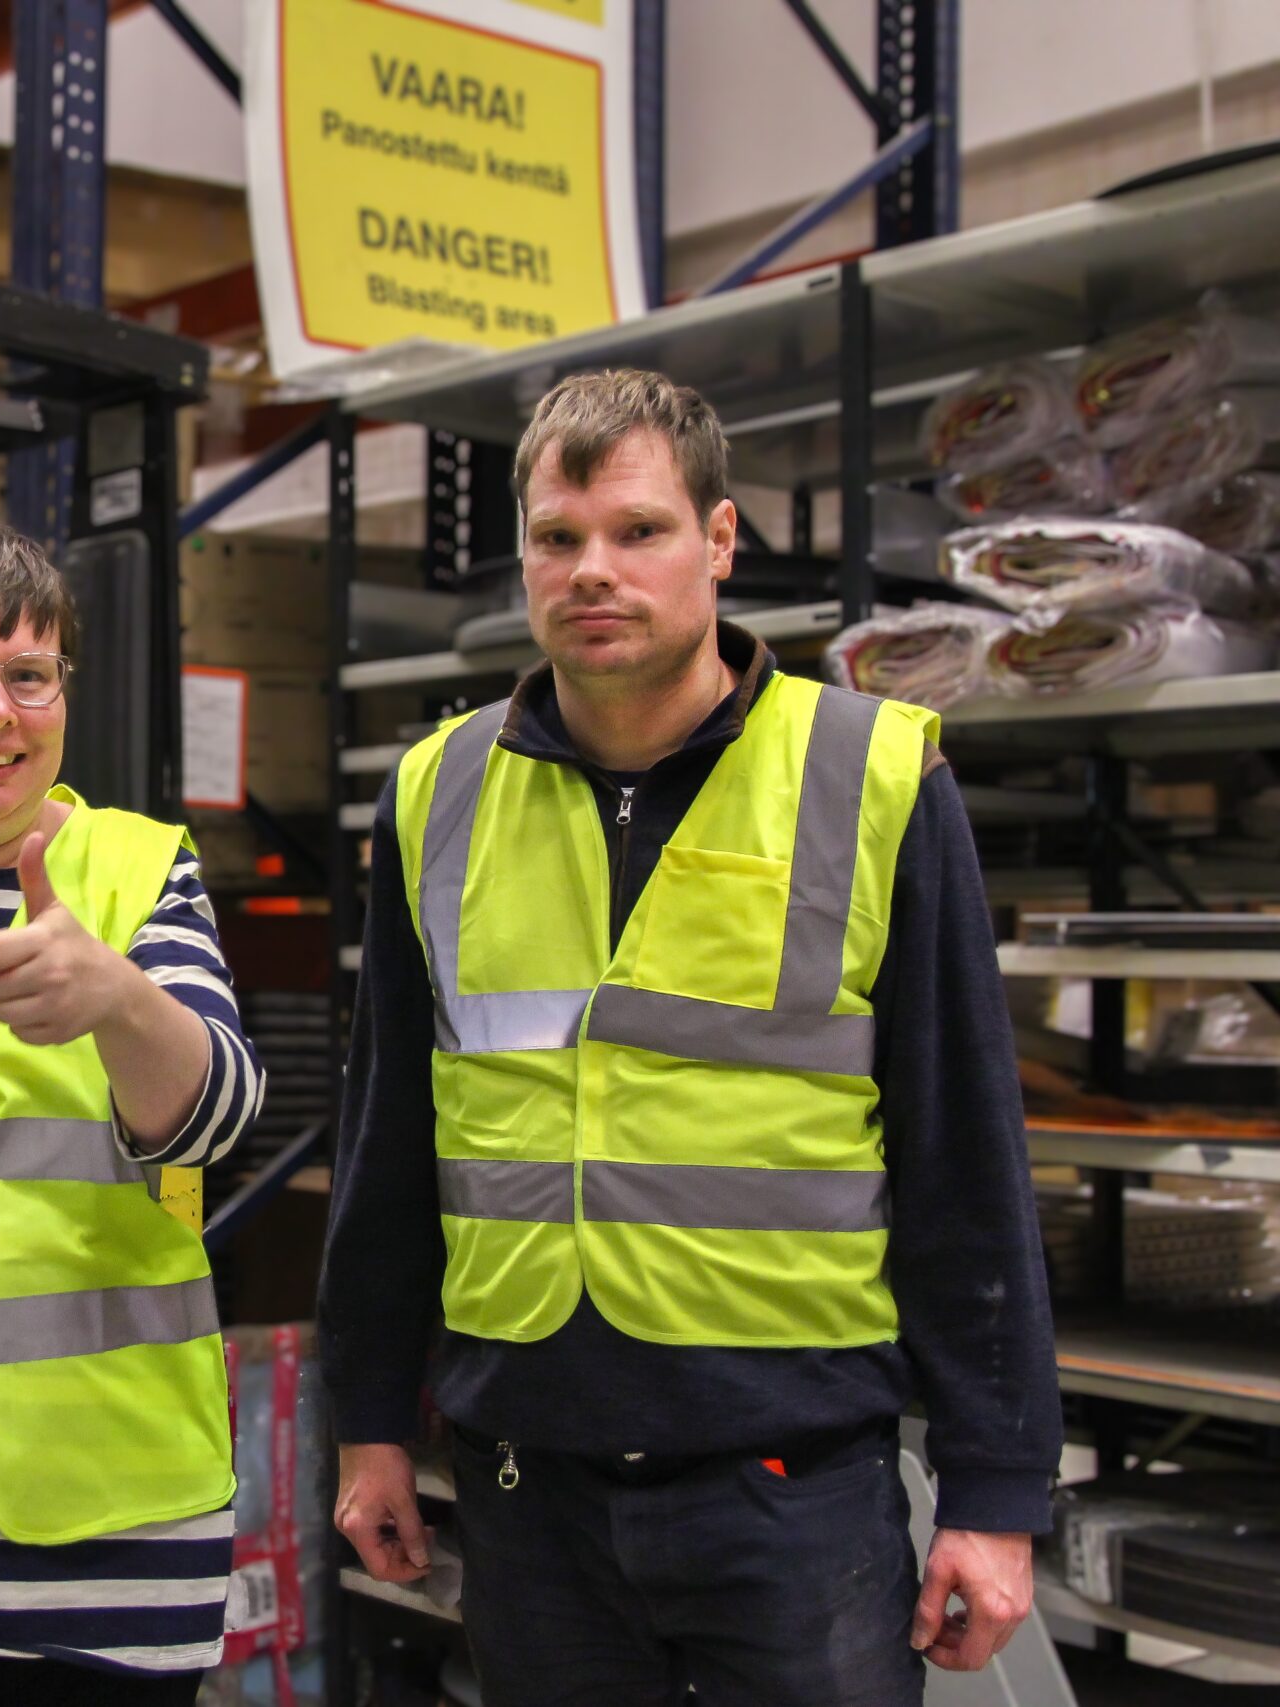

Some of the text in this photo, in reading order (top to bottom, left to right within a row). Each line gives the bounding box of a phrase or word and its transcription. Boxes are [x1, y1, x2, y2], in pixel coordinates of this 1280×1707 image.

[370, 52, 526, 131] VAARA!
[321, 108, 570, 196] Panostettu kenttä
[357, 207, 551, 285] DANGER!
[367, 274, 556, 338] Blasting area
